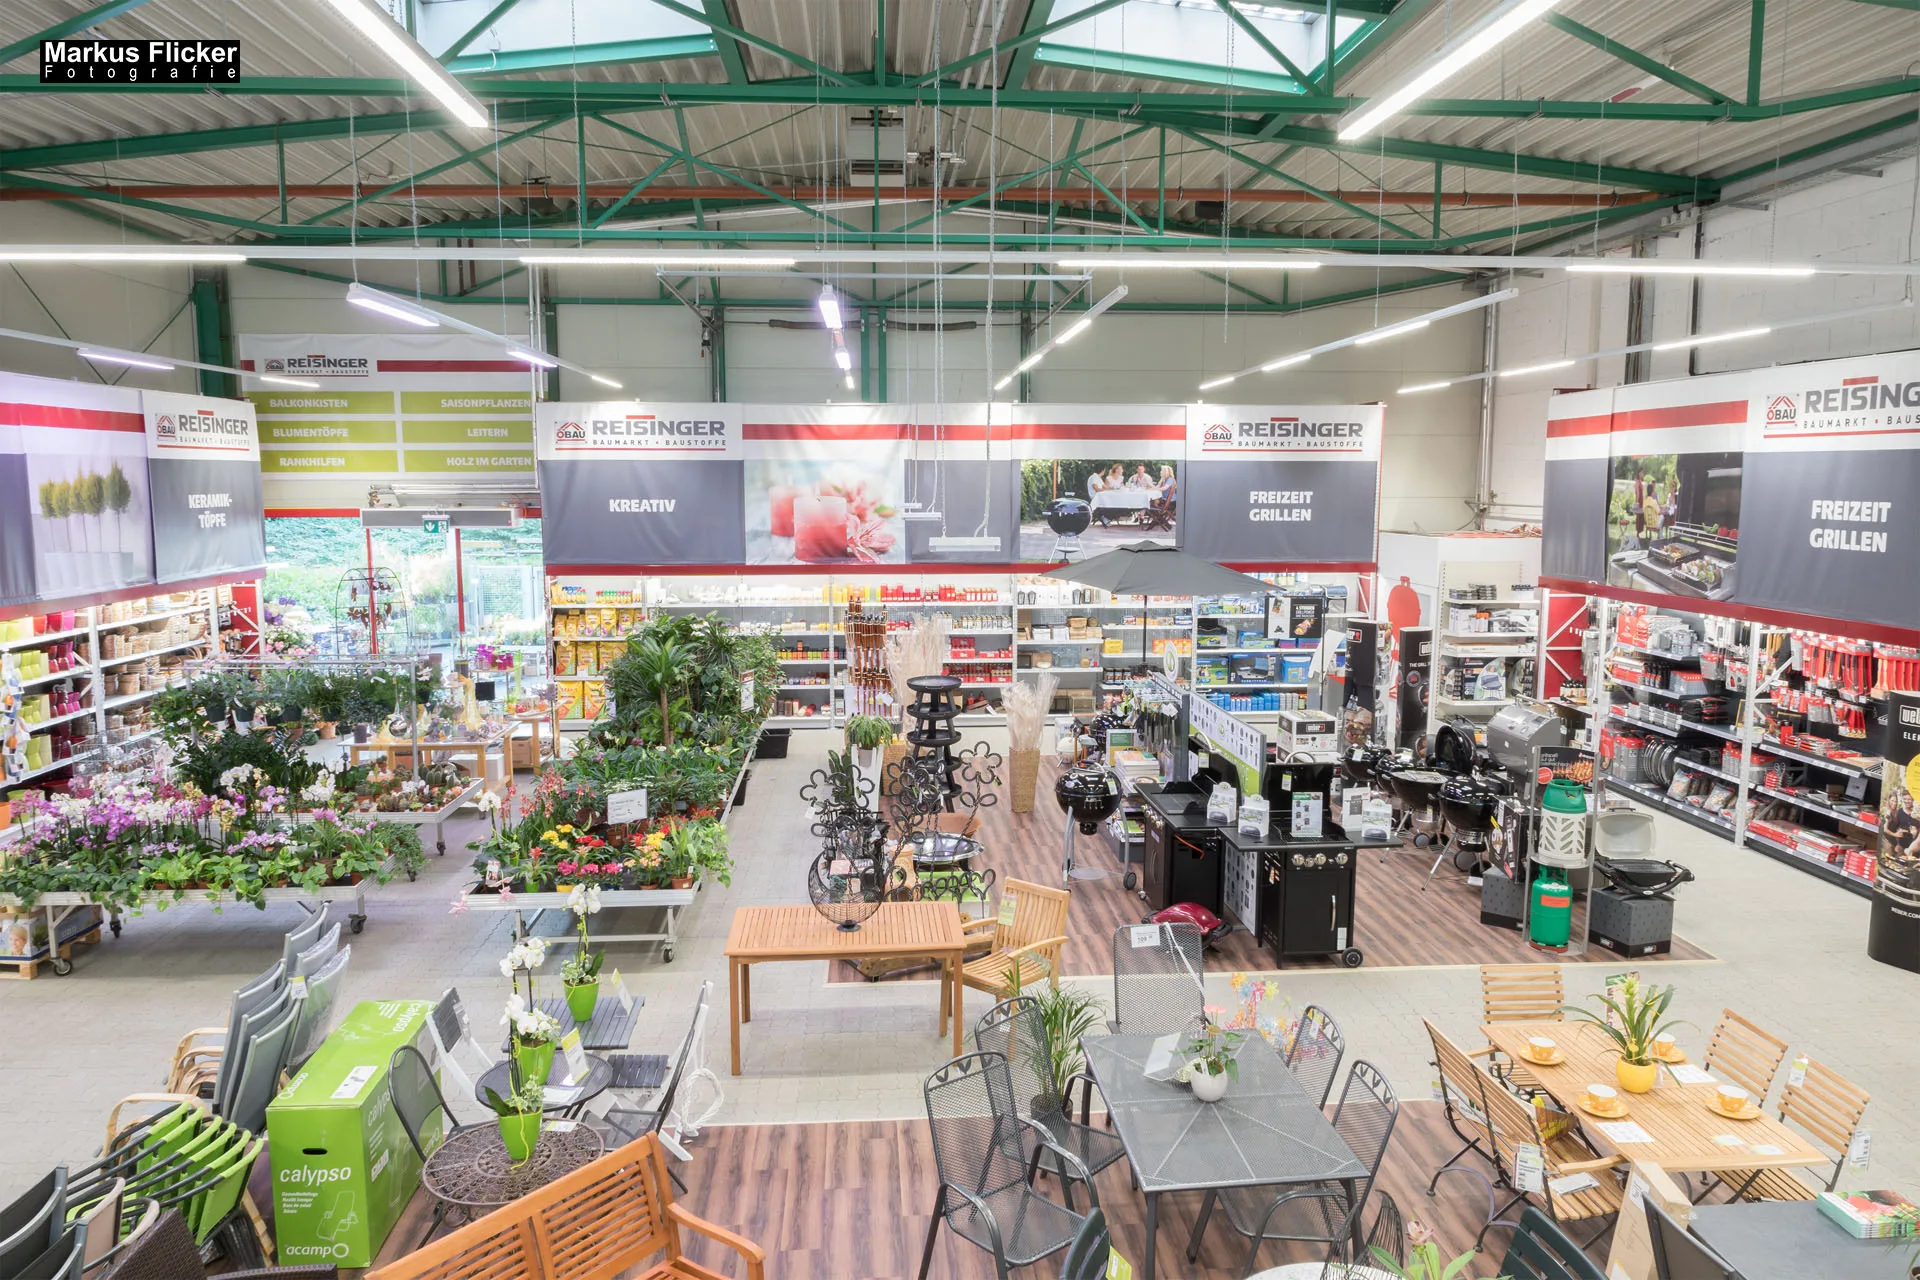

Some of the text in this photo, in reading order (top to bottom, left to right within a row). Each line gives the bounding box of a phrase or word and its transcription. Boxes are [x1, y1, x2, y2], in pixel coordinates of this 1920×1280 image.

[287, 358, 368, 368] REISINGER
[269, 399, 348, 408] BALKONKISTEN
[440, 399, 531, 408] SAISONPFLANZEN
[178, 414, 249, 435] REISINGER
[592, 420, 726, 436] REISINGER
[1238, 422, 1364, 438] REISINGER
[1803, 417, 1868, 429] BAUMARKT
[272, 426, 349, 437] BLUMENTÖPFE
[467, 428, 508, 437] LEITERN
[279, 457, 346, 467] RANKHILFEN
[446, 457, 532, 466] HOLZ IM GARTEN
[188, 493, 232, 509] KERAMIK-
[1249, 490, 1314, 504] FREIZEIT
[609, 499, 676, 513] KREATIV
[1811, 500, 1892, 523] FREIZEIT
[198, 510, 227, 529] TÖPFE
[1249, 508, 1312, 522] GRILLEN
[1809, 528, 1888, 553] GRILLEN
[368, 1087, 391, 1127] calyp
[280, 1164, 352, 1187] calypso
